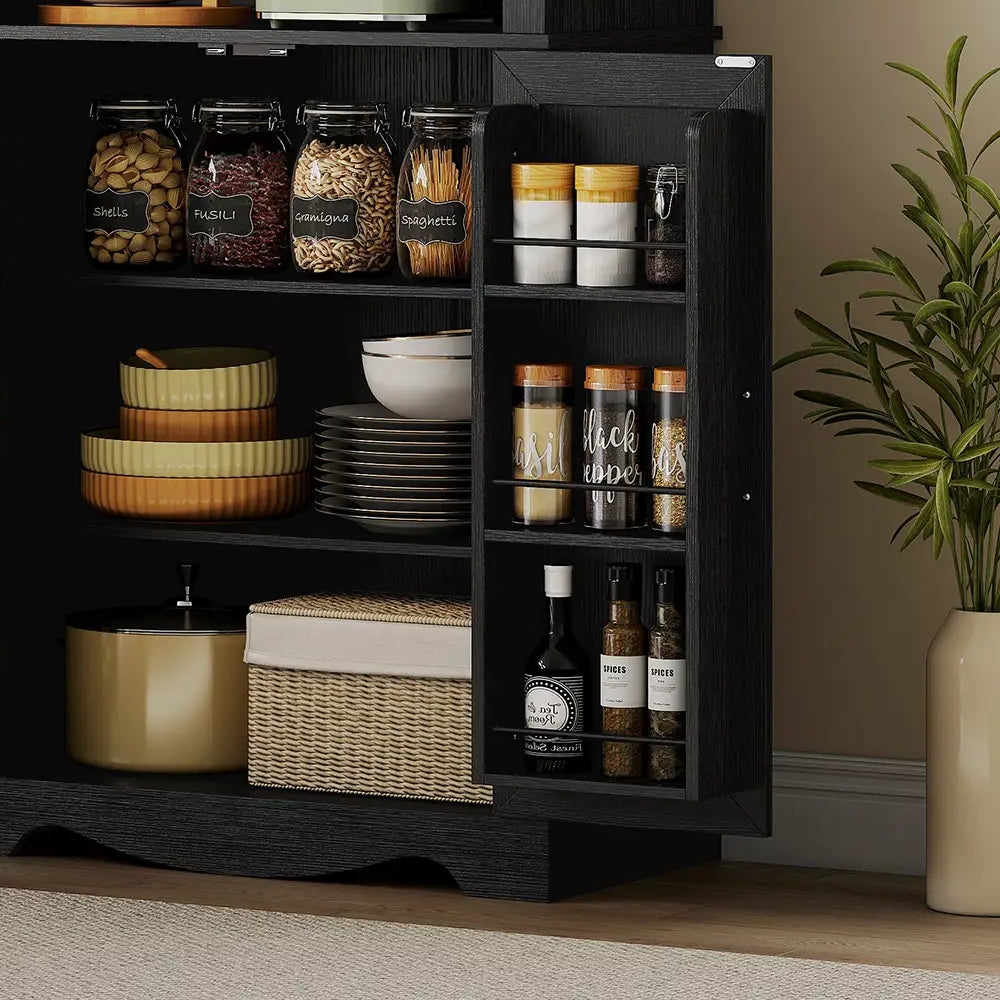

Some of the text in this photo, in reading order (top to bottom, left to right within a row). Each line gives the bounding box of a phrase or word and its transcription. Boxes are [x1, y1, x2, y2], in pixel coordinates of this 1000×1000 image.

[92, 205, 129, 218] Shells
[401, 214, 457, 229] Spaghetti
[513, 410, 569, 479] asil
[583, 461, 643, 504] epper
[603, 664, 627, 674] SPICES
[651, 668, 675, 677] SPICES
